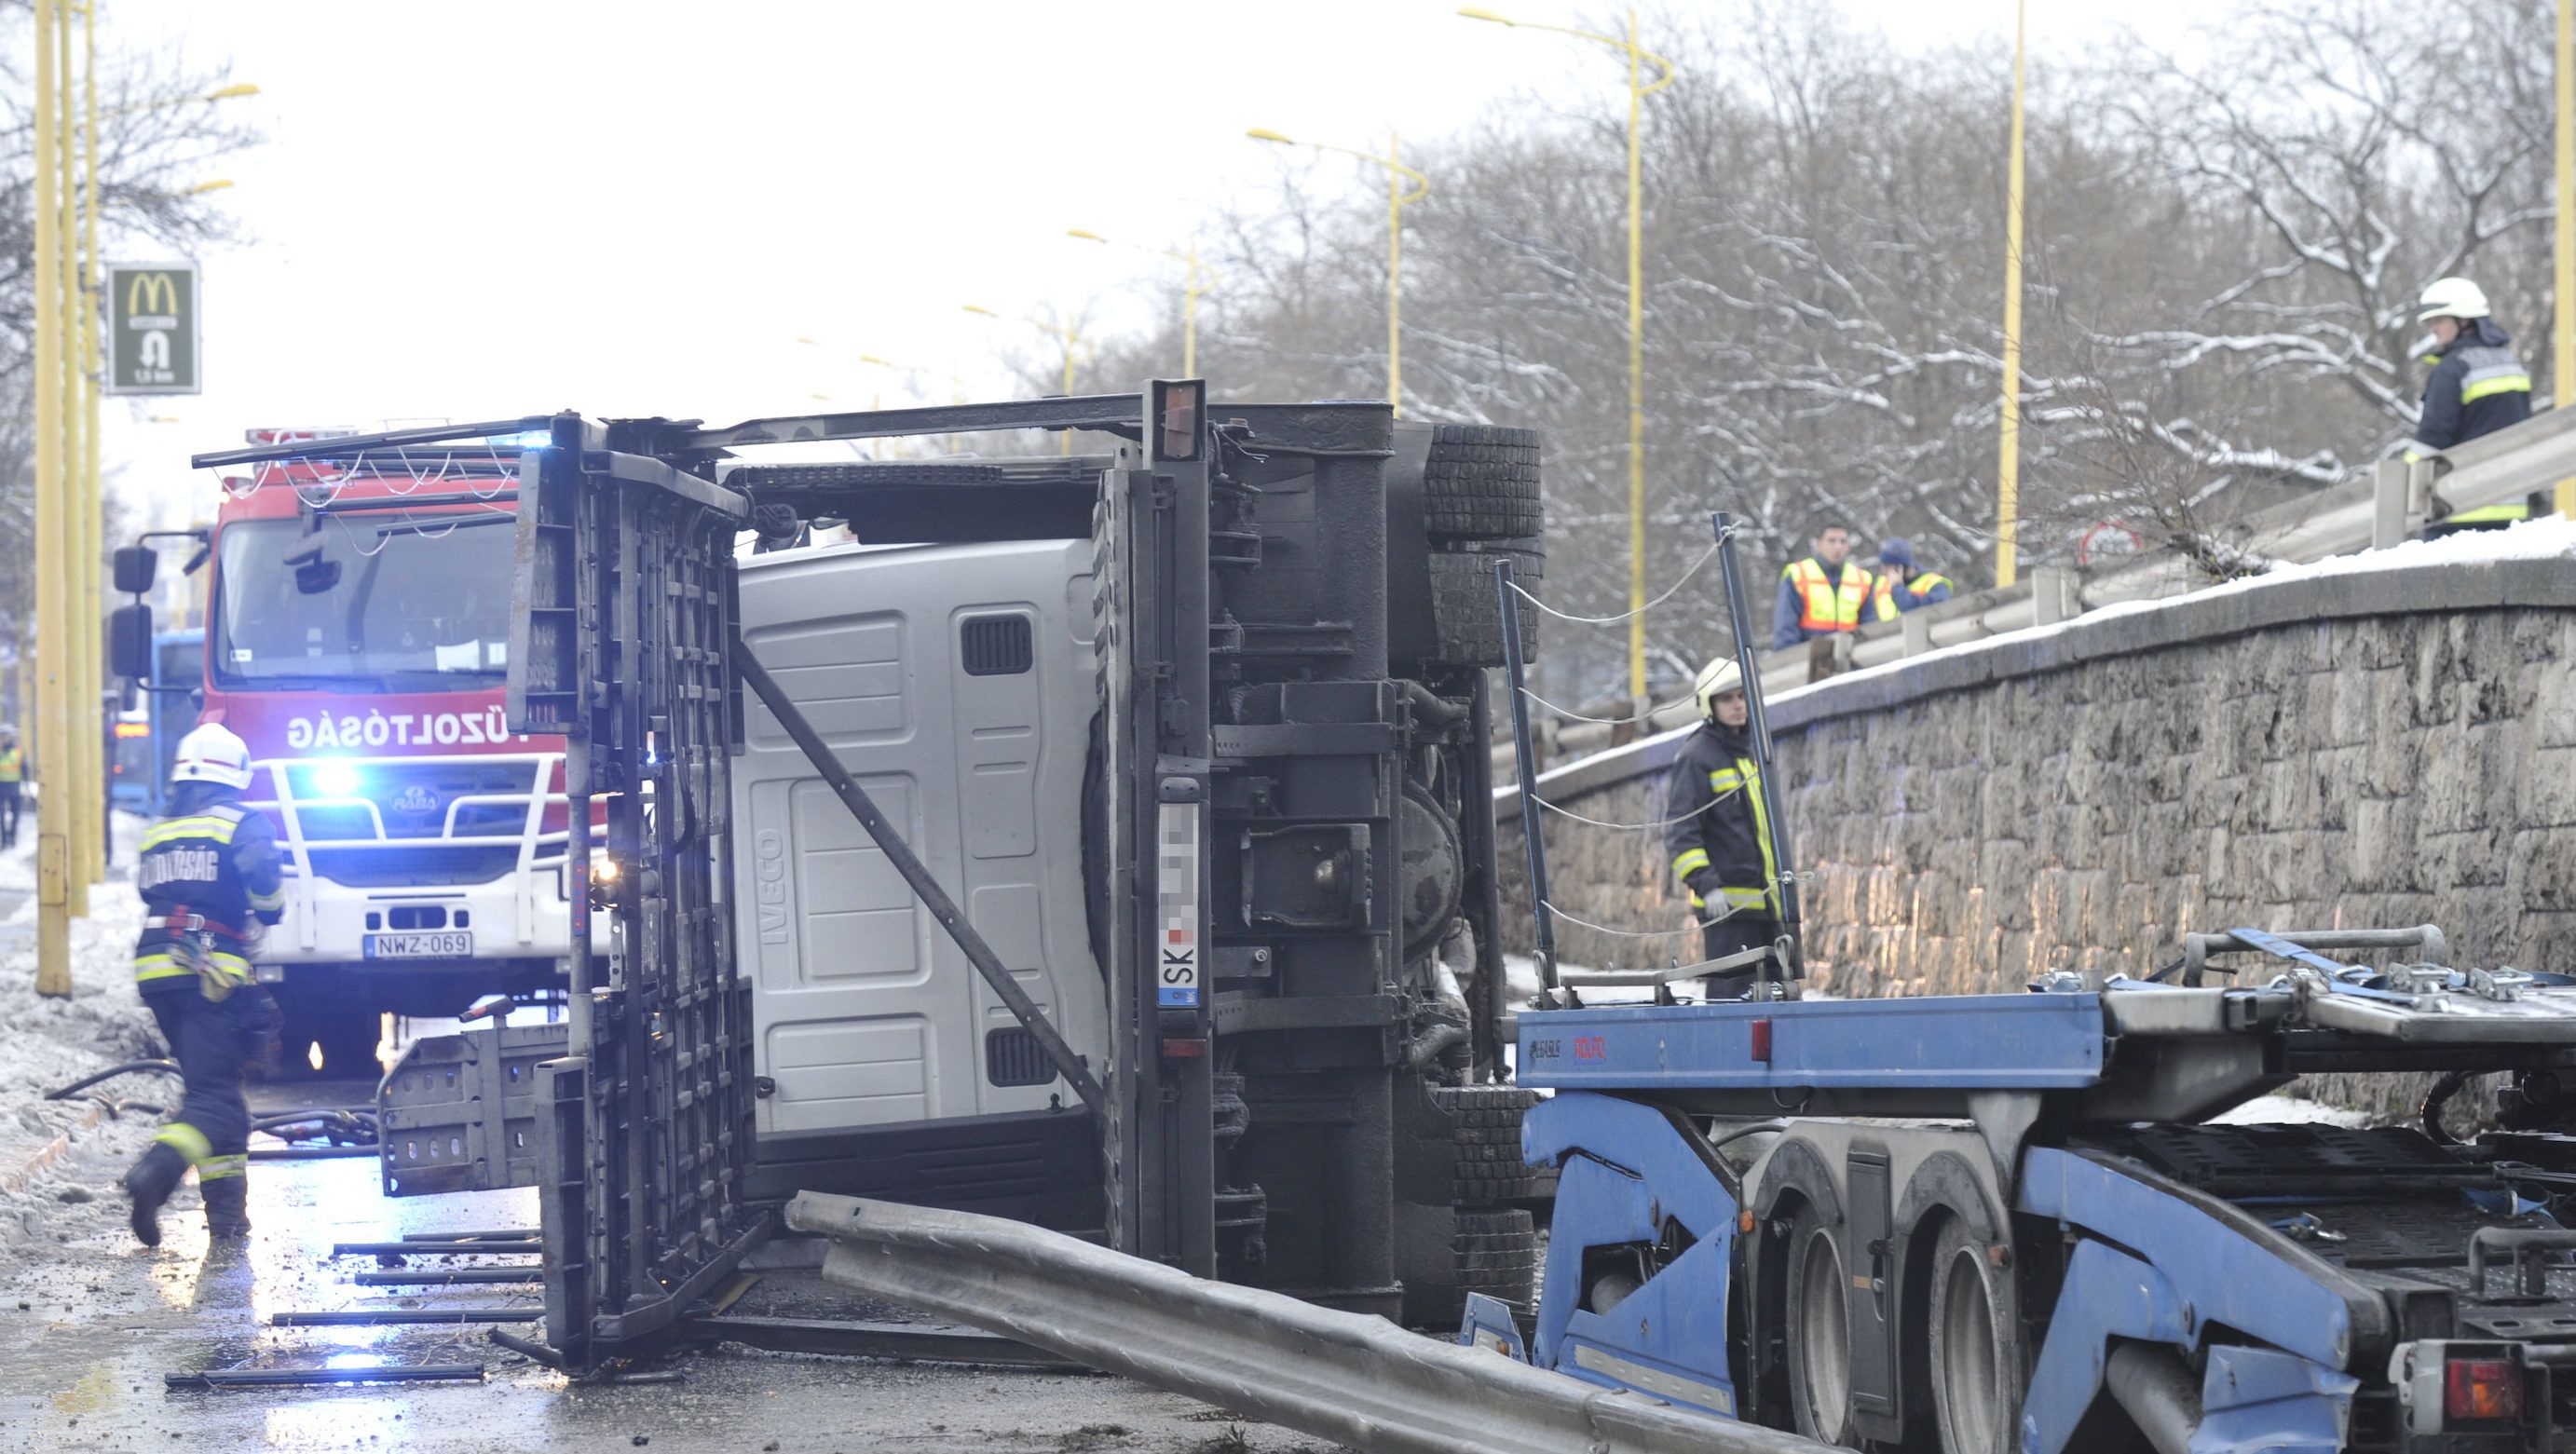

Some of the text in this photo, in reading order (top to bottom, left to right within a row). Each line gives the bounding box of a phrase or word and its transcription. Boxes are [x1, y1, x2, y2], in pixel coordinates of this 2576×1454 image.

[756, 827, 789, 946] IVECO
[378, 934, 467, 955] NWZ-069
[1163, 947, 1193, 985] SK
